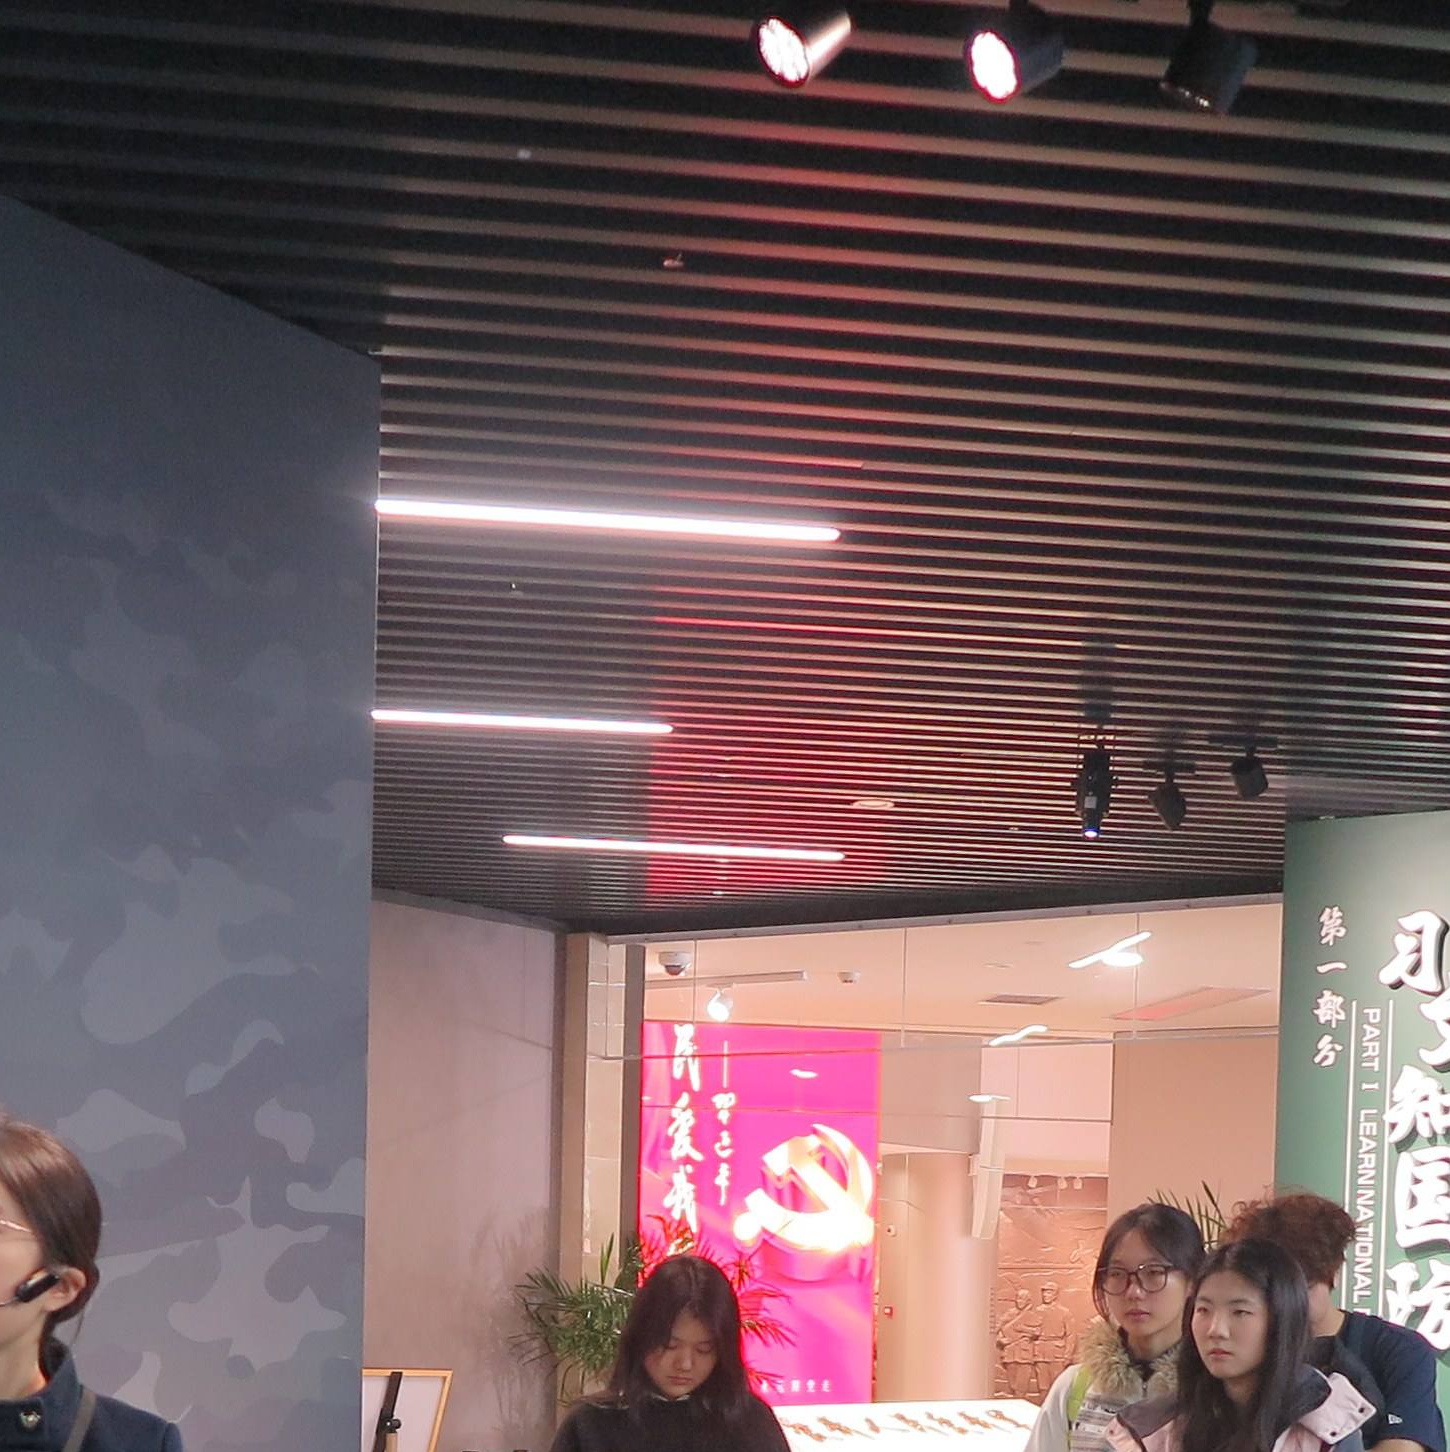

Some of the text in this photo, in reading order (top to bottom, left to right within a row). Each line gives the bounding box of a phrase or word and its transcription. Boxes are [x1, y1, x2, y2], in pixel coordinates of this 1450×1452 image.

[1313, 906, 1347, 1066] 第一部分
[1360, 1008, 1381, 1071] PART
[1361, 1081, 1378, 1090] I
